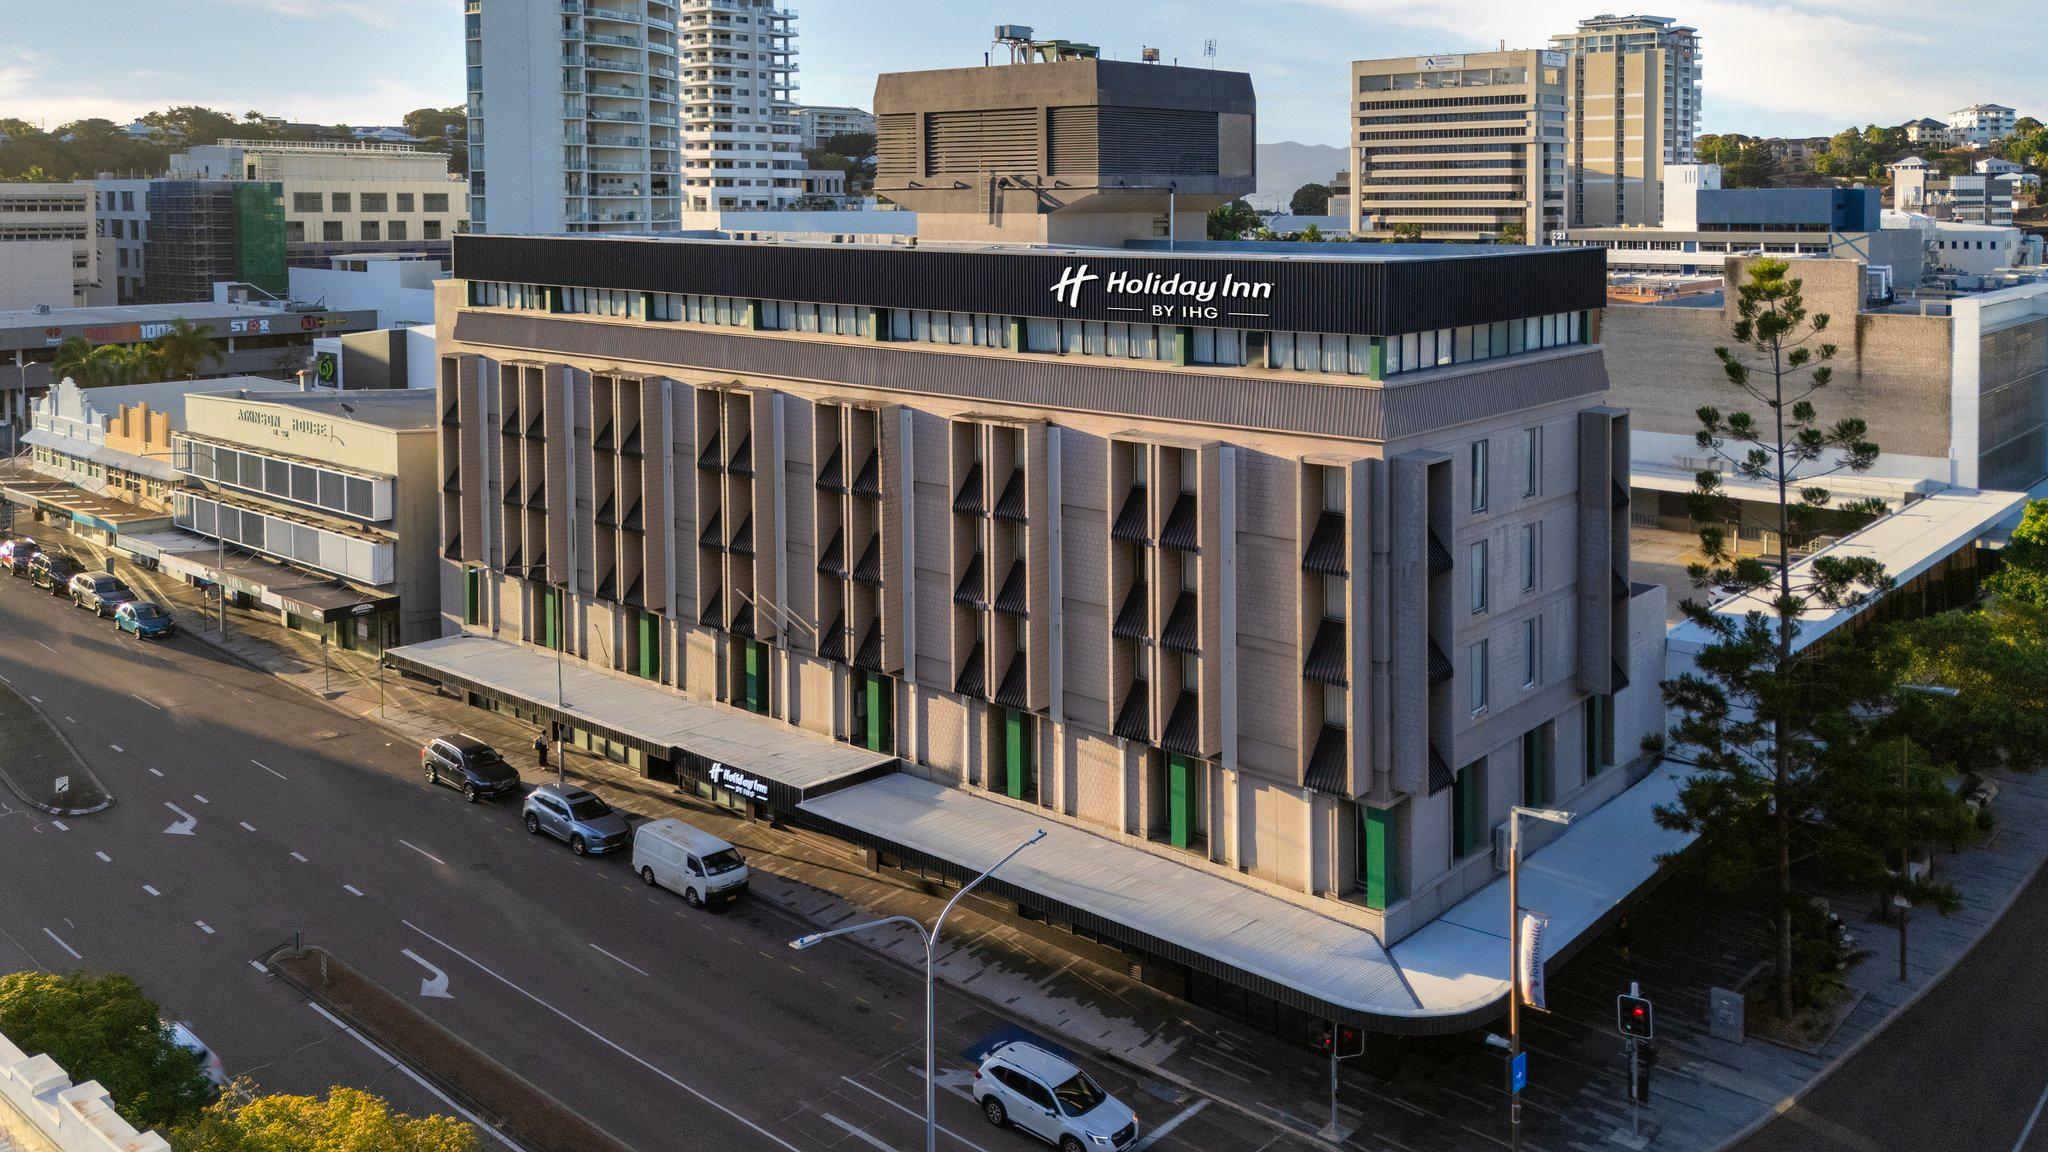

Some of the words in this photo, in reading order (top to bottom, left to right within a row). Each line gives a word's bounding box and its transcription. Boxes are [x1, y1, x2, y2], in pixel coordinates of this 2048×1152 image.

[1107, 270, 1217, 302] Holiday
[1221, 273, 1273, 299] Inn
[1152, 304, 1174, 317] BY
[1182, 306, 1218, 319] IHG
[238, 408, 281, 428] ATKINSON
[293, 418, 327, 437] HOUSE
[723, 769, 754, 790] Holiday
[753, 779, 768, 794] Inn
